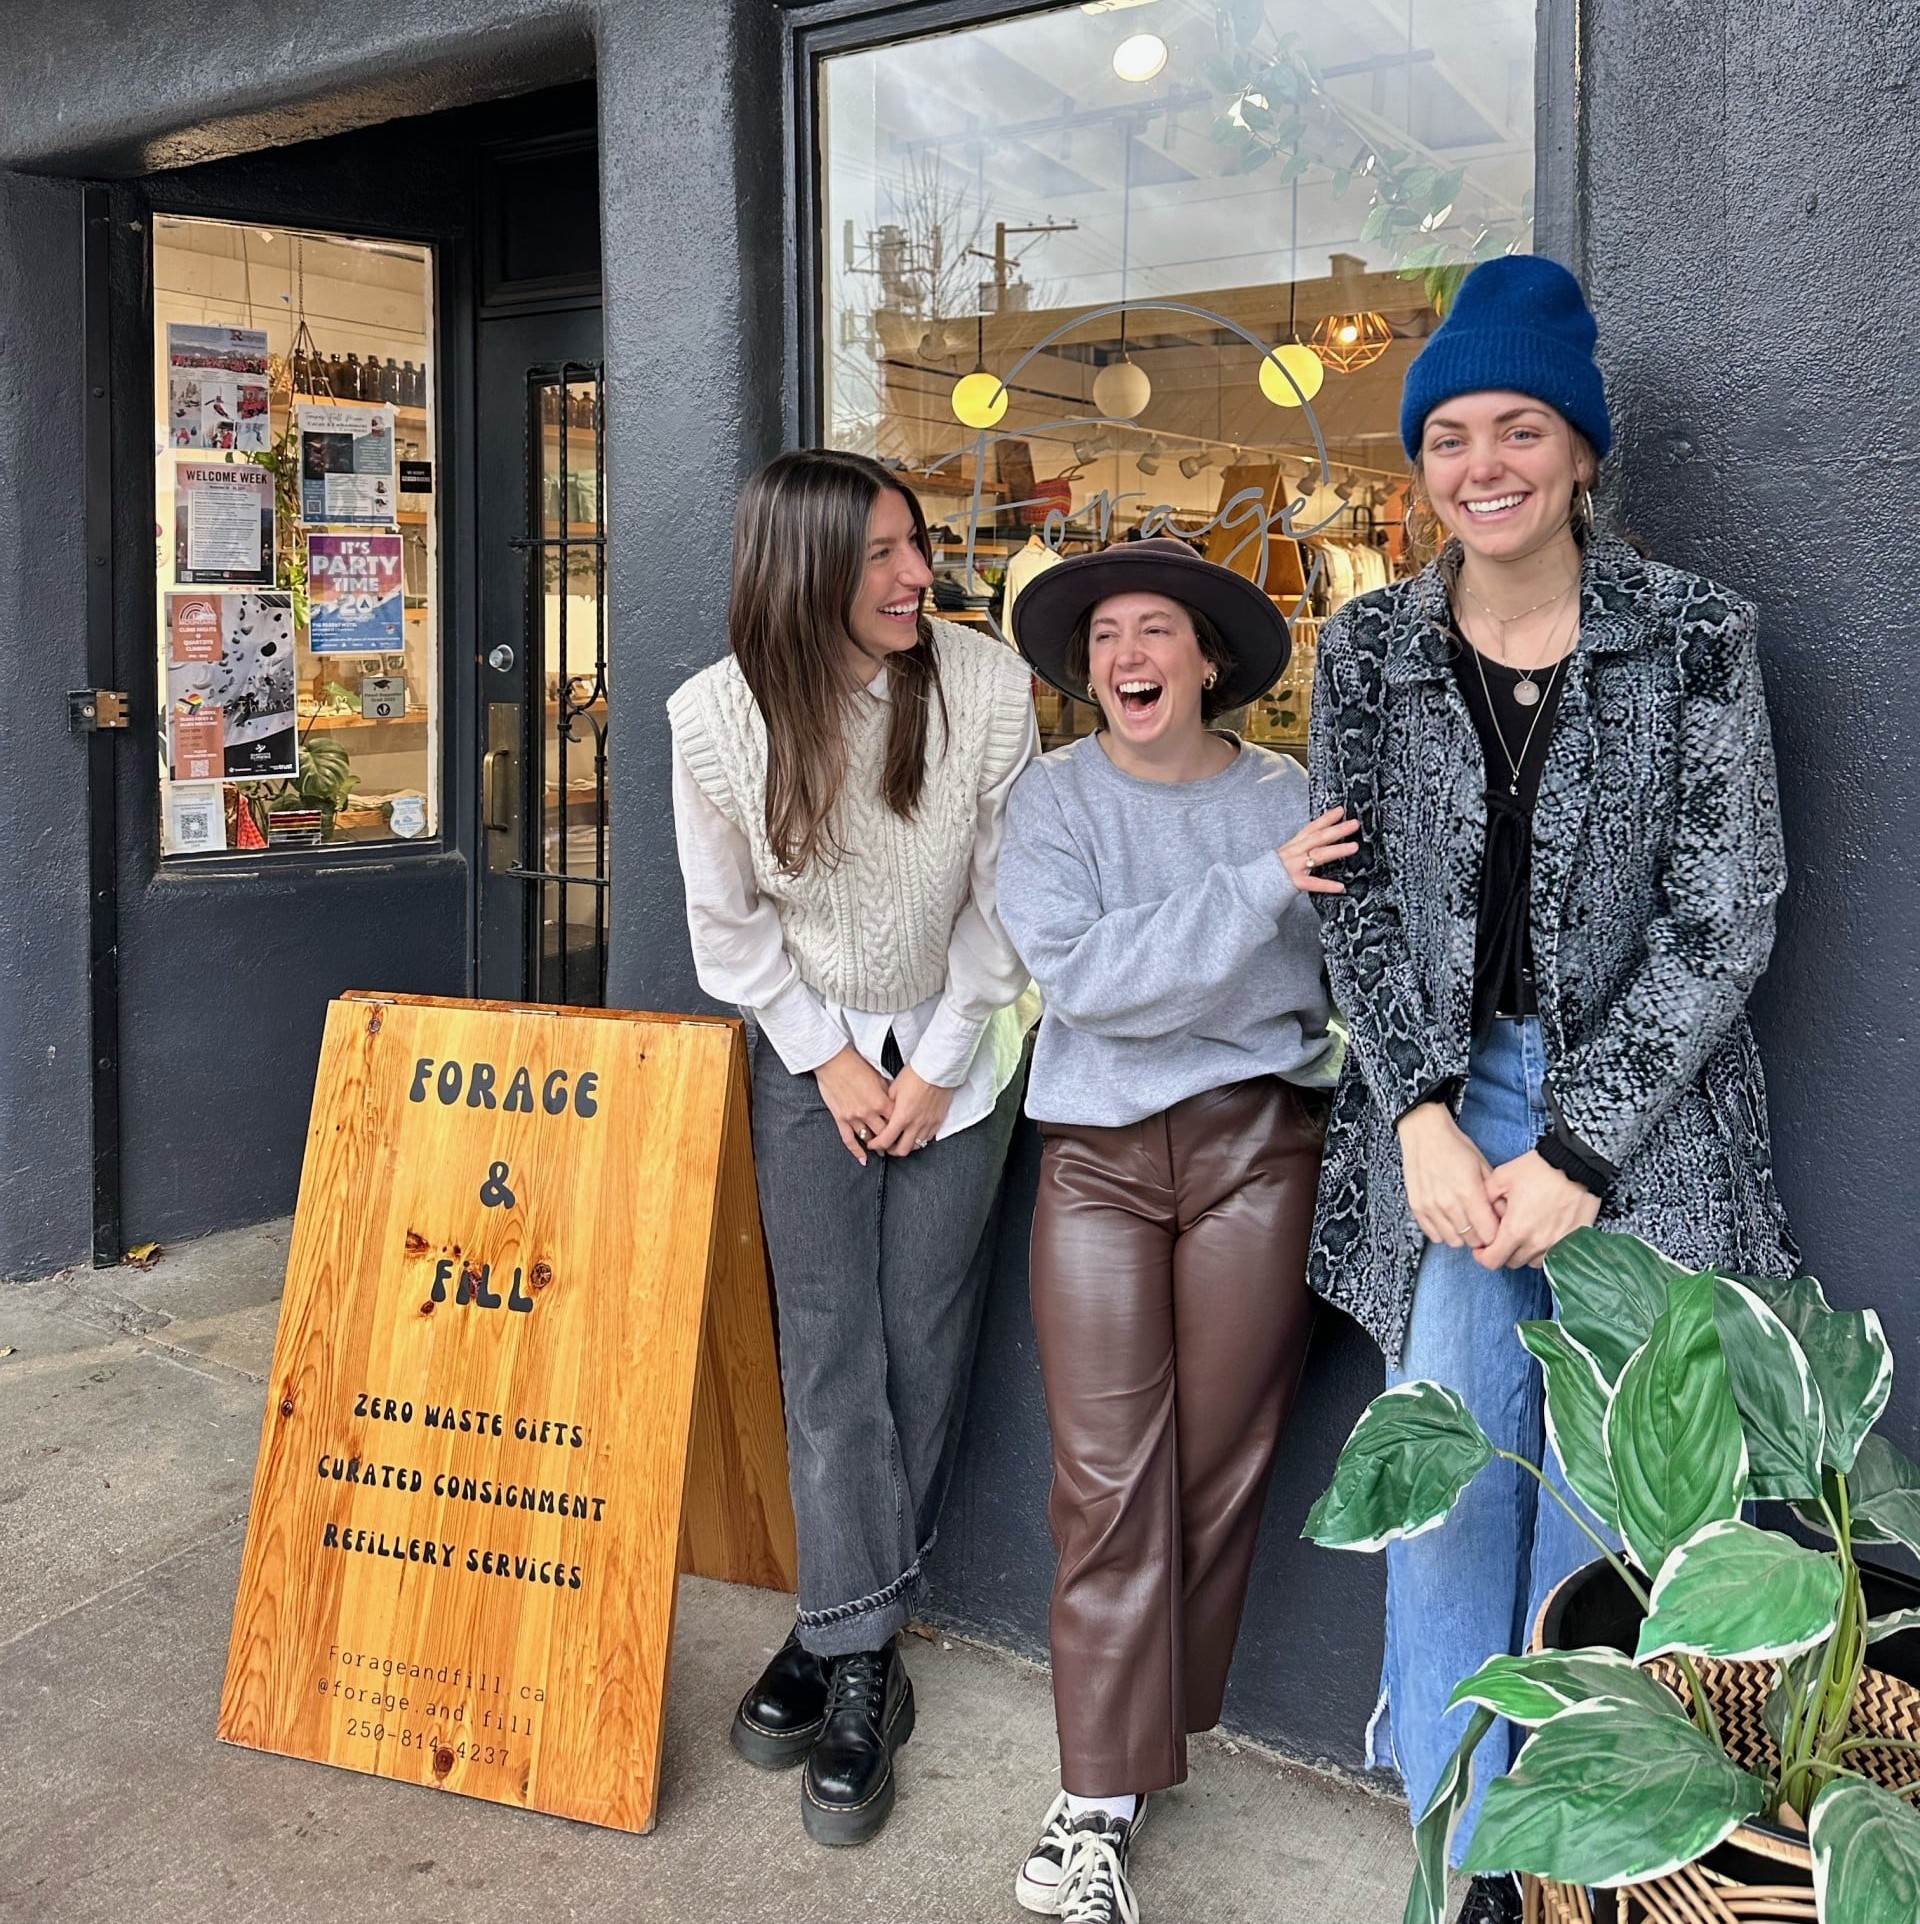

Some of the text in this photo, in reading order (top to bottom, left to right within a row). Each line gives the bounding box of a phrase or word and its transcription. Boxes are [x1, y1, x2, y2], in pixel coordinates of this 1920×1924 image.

[187, 470, 268, 485] WELCOME WEEK
[925, 417, 1350, 594] Forage
[312, 555, 399, 576] PARTY
[341, 541, 371, 555] IT'S
[333, 578, 380, 592] TIME
[409, 1058, 599, 1118] FORAGE
[479, 1161, 516, 1209] &
[354, 1393, 413, 1423] ZERO
[424, 1404, 503, 1437] WASTE
[318, 1454, 423, 1493] CURATED
[346, 1718, 509, 1767] 250-8144237
